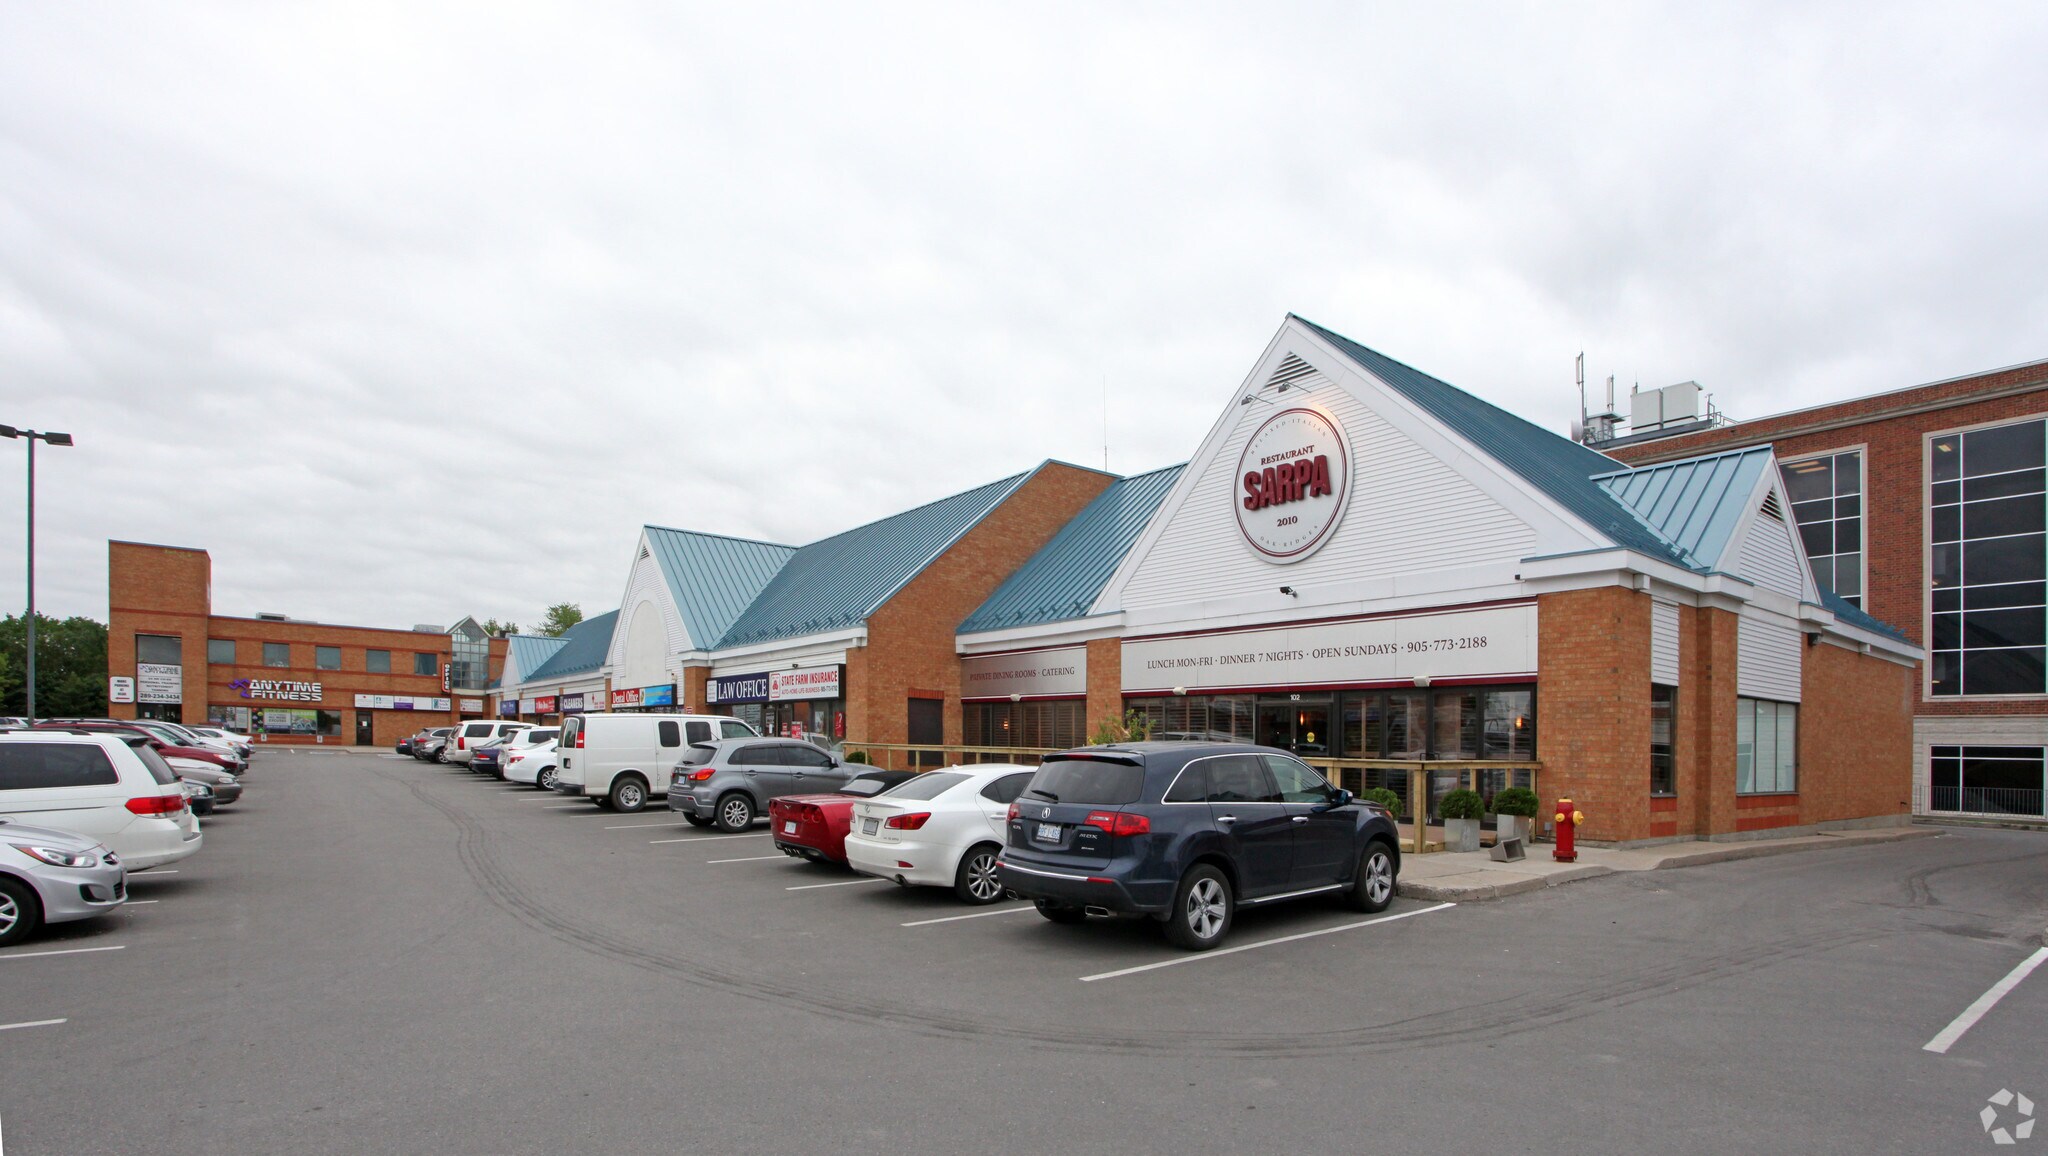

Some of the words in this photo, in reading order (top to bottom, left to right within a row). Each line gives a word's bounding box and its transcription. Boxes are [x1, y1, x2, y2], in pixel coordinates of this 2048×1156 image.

[1260, 445, 1315, 465] RESTAURANT
[1243, 454, 1332, 511] SARPA
[1276, 515, 1298, 527] 2010
[1147, 659, 1175, 669] LUNCH
[1176, 656, 1213, 668] MON-FRI
[1220, 653, 1256, 665] DINNER
[1258, 653, 1264, 662] 7
[1266, 650, 1304, 662] NIGHTS
[1312, 647, 1341, 659] OPEN
[1344, 643, 1398, 657] SUNDAYS
[781, 675, 795, 686] STATE
[795, 673, 809, 685] FARM
[809, 671, 838, 684] INSURANCE
[969, 672, 993, 681] PRIVATE
[992, 670, 1014, 680] DINING
[1014, 669, 1037, 678] ROOMS
[1041, 666, 1075, 677] CATERING
[249, 679, 322, 692] ANYTIME
[718, 682, 736, 700] LAW
[736, 679, 768, 699] OFFICE
[251, 690, 323, 702] FITNESS
[563, 697, 583, 709] CLEANERS
[612, 691, 625, 704] Dental
[626, 690, 639, 703] Office
